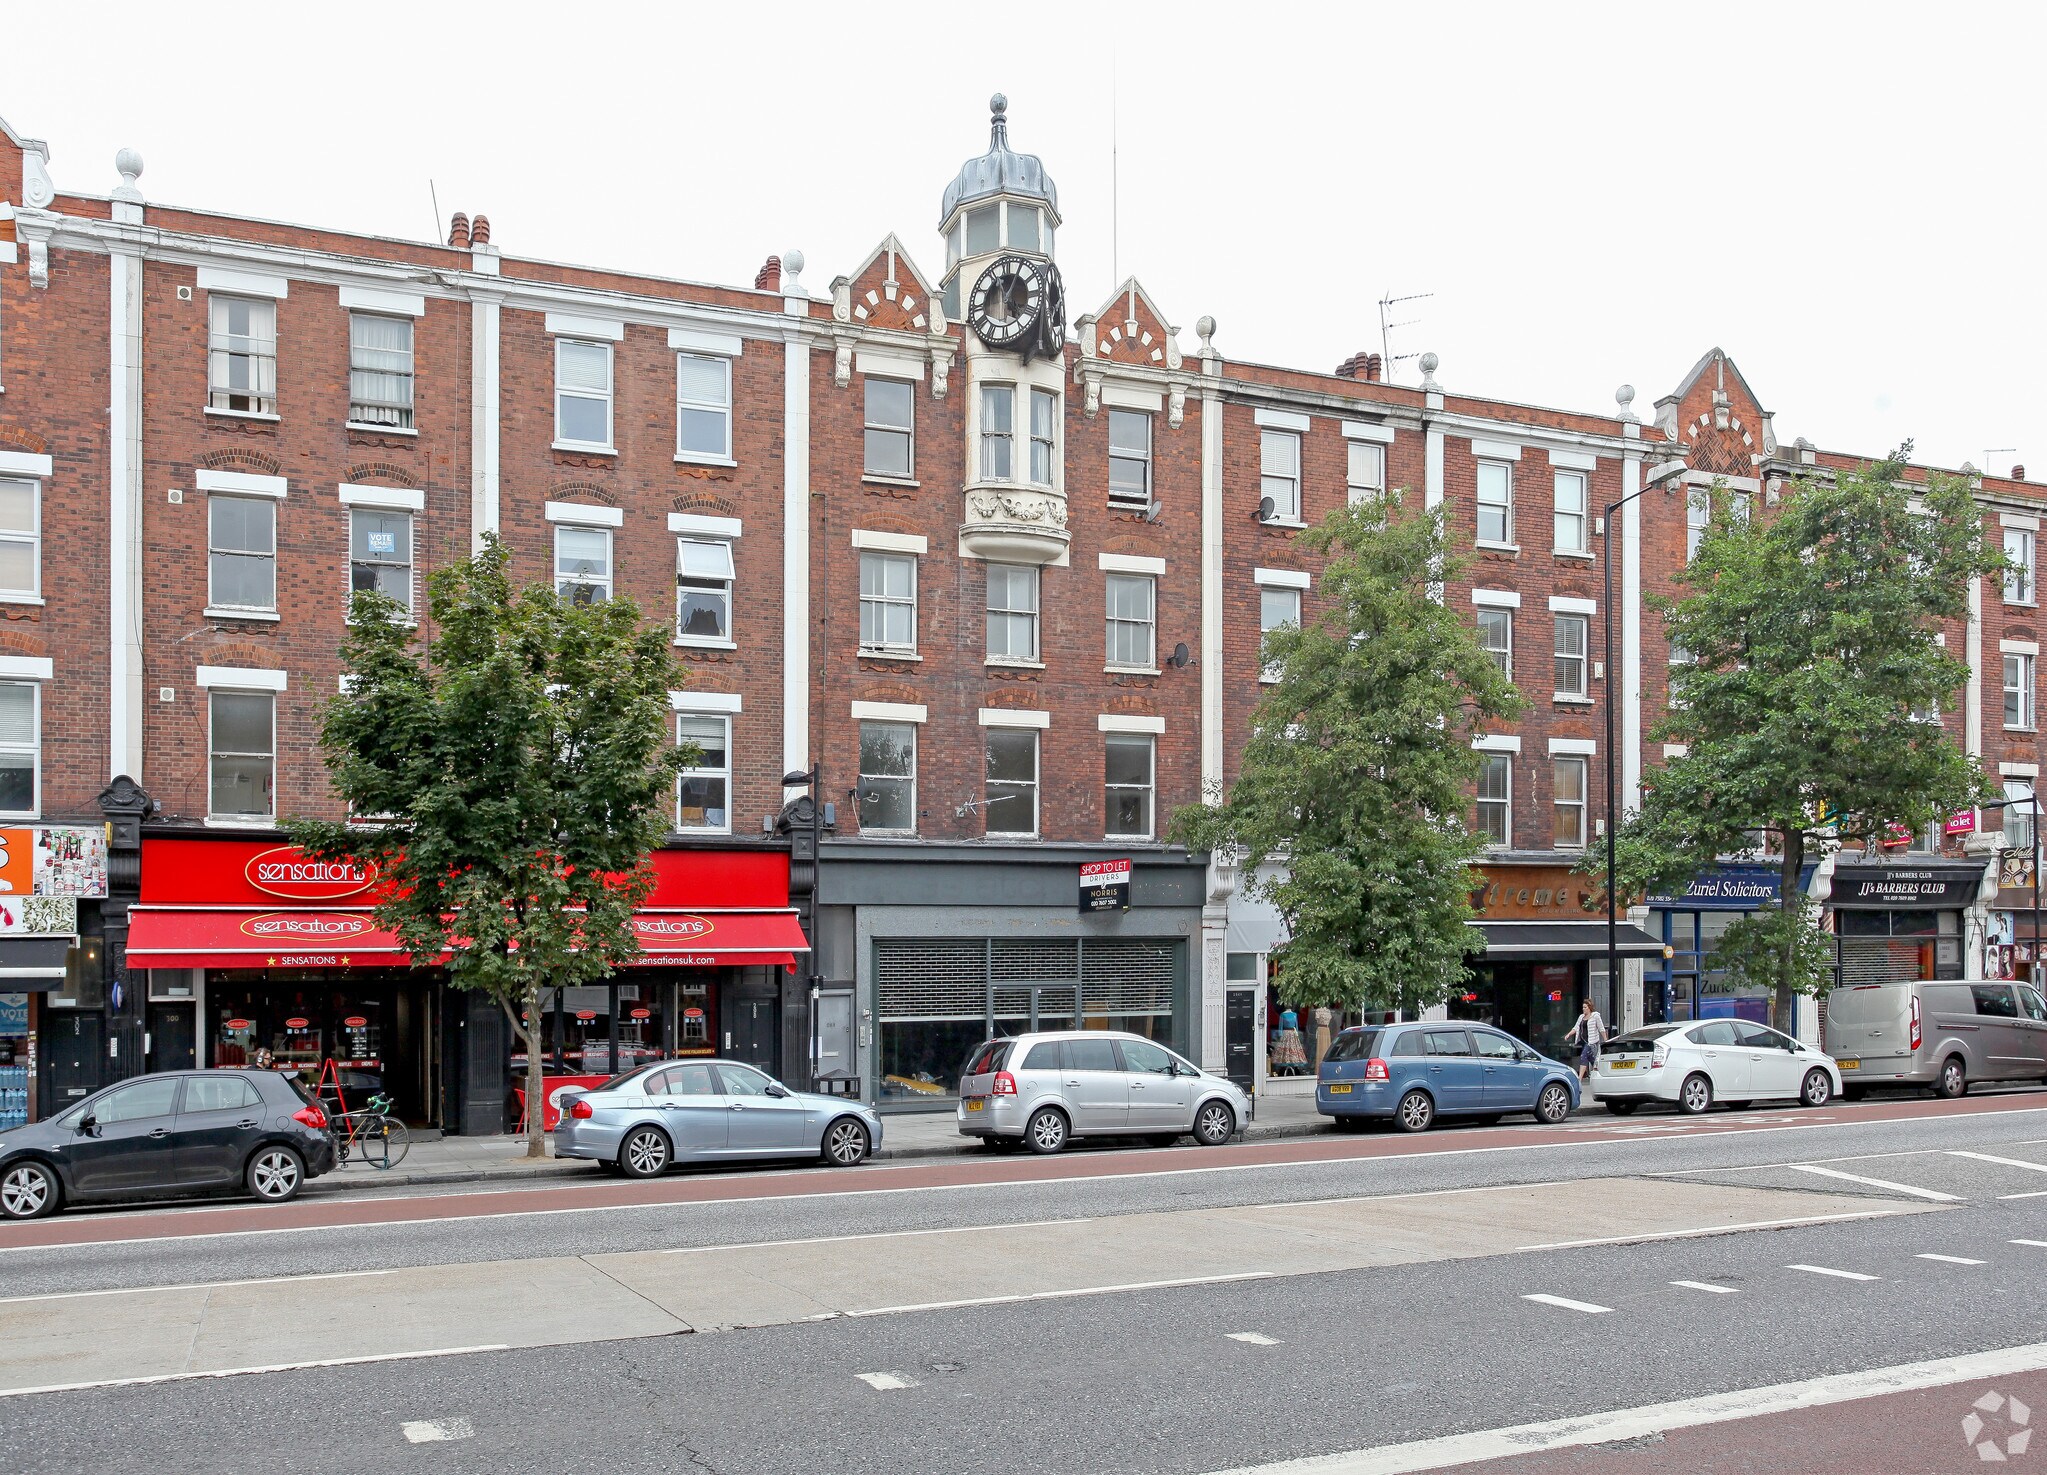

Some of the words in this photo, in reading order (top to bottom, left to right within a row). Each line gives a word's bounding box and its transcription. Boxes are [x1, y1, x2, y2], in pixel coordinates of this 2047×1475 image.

[370, 533, 392, 542] VOTE
[1960, 816, 1971, 827] let
[1082, 864, 1101, 875] SHOP
[1103, 862, 1113, 873] TO
[1114, 862, 1127, 871] LET
[1090, 873, 1119, 882] DRIVERS
[1091, 889, 1118, 897] NORRIS
[1687, 880, 1720, 896] Zuriel
[1721, 881, 1773, 897] Solicitors
[1858, 882, 1875, 896] JJ's
[1875, 882, 1919, 894] BARBERS
[1920, 883, 1946, 894] CLUB
[254, 919, 362, 932] sensations
[628, 919, 704, 933] nsations
[281, 956, 336, 965] SENSATIONS
[631, 955, 715, 965] .sensationsuk.com
[1, 1008, 28, 1020] VOTE
